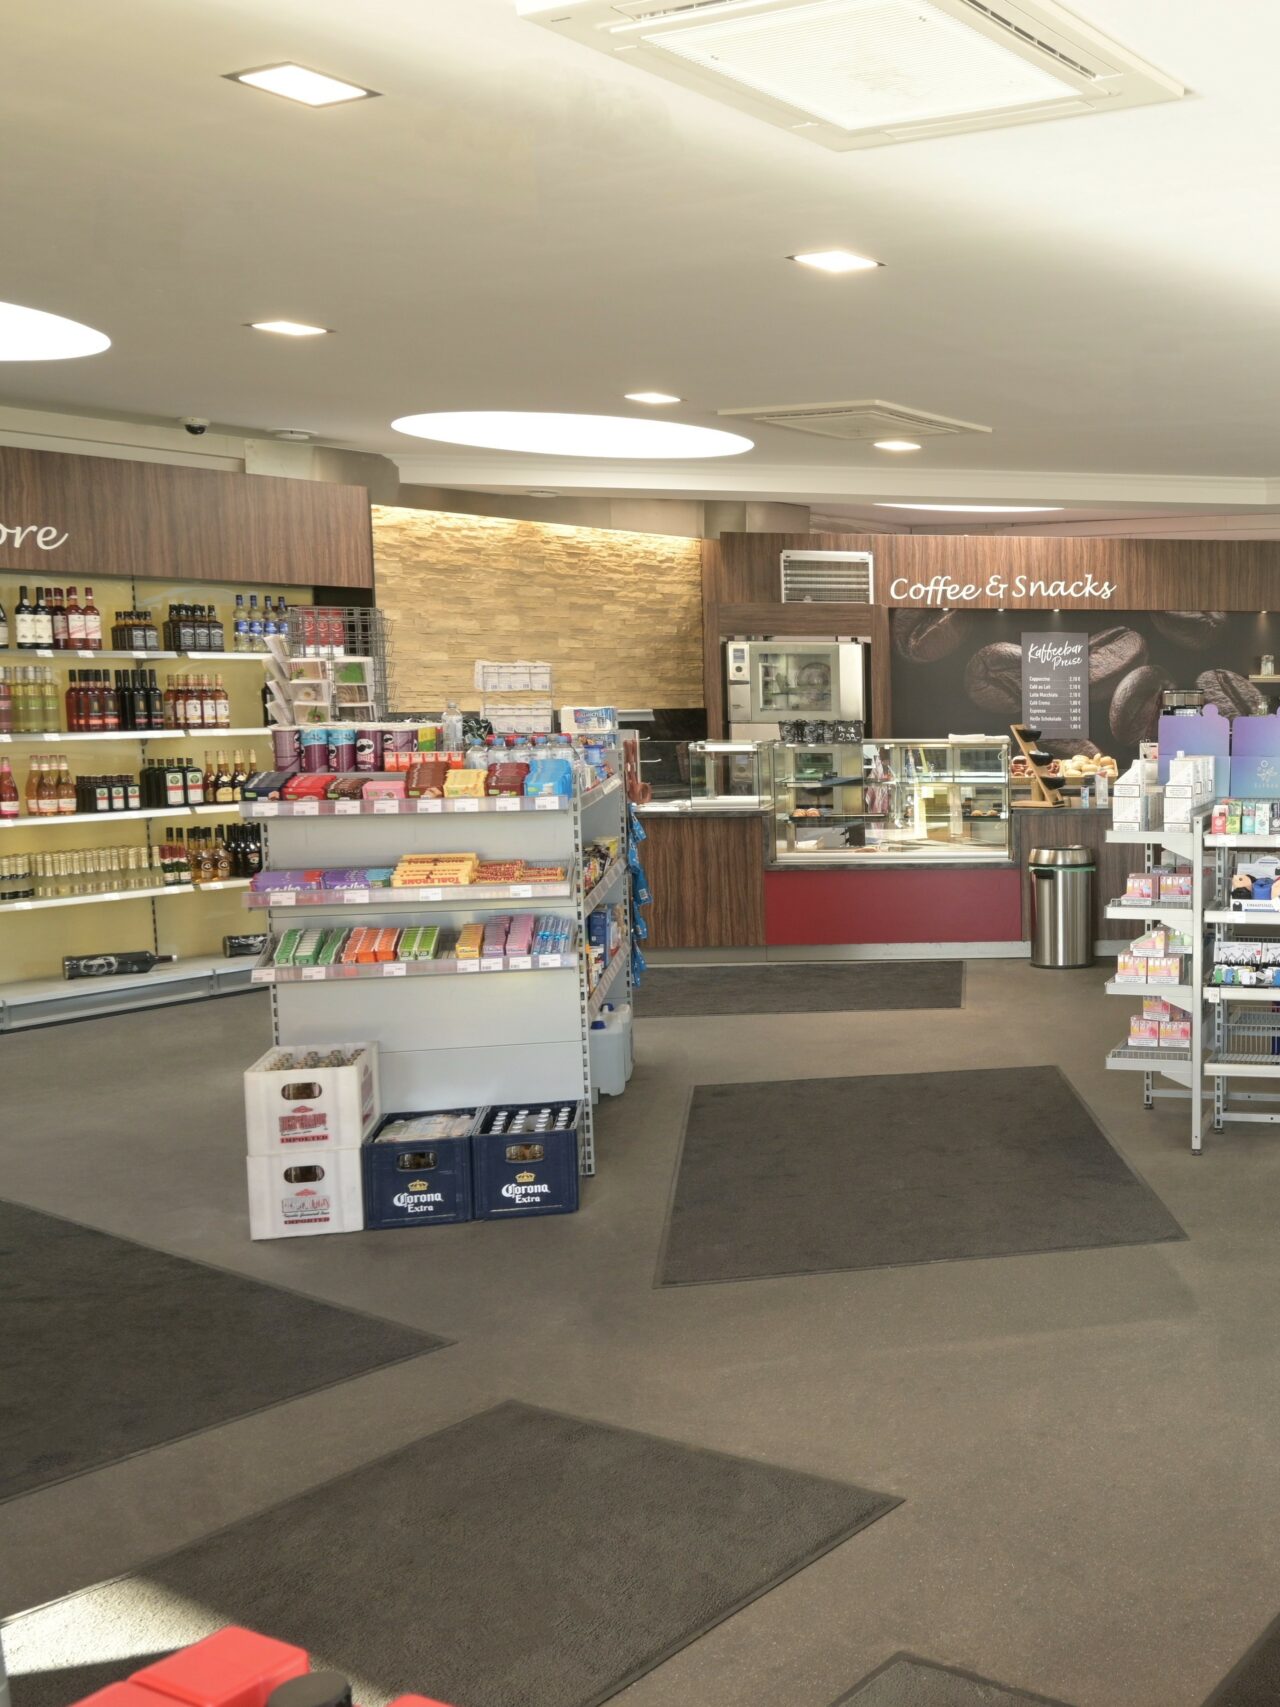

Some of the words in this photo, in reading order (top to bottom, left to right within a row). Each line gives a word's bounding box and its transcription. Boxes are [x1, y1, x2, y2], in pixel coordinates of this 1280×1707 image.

[890, 575, 982, 605] Coffee
[985, 574, 1009, 599] &
[1012, 574, 1118, 600] Snacks
[1028, 641, 1083, 664] Kaffeebar
[1052, 655, 1083, 671] Preise
[502, 1182, 551, 1199] Corona
[394, 1192, 444, 1208] Corona
[515, 1194, 540, 1204] Extra
[408, 1204, 433, 1213] Extra
